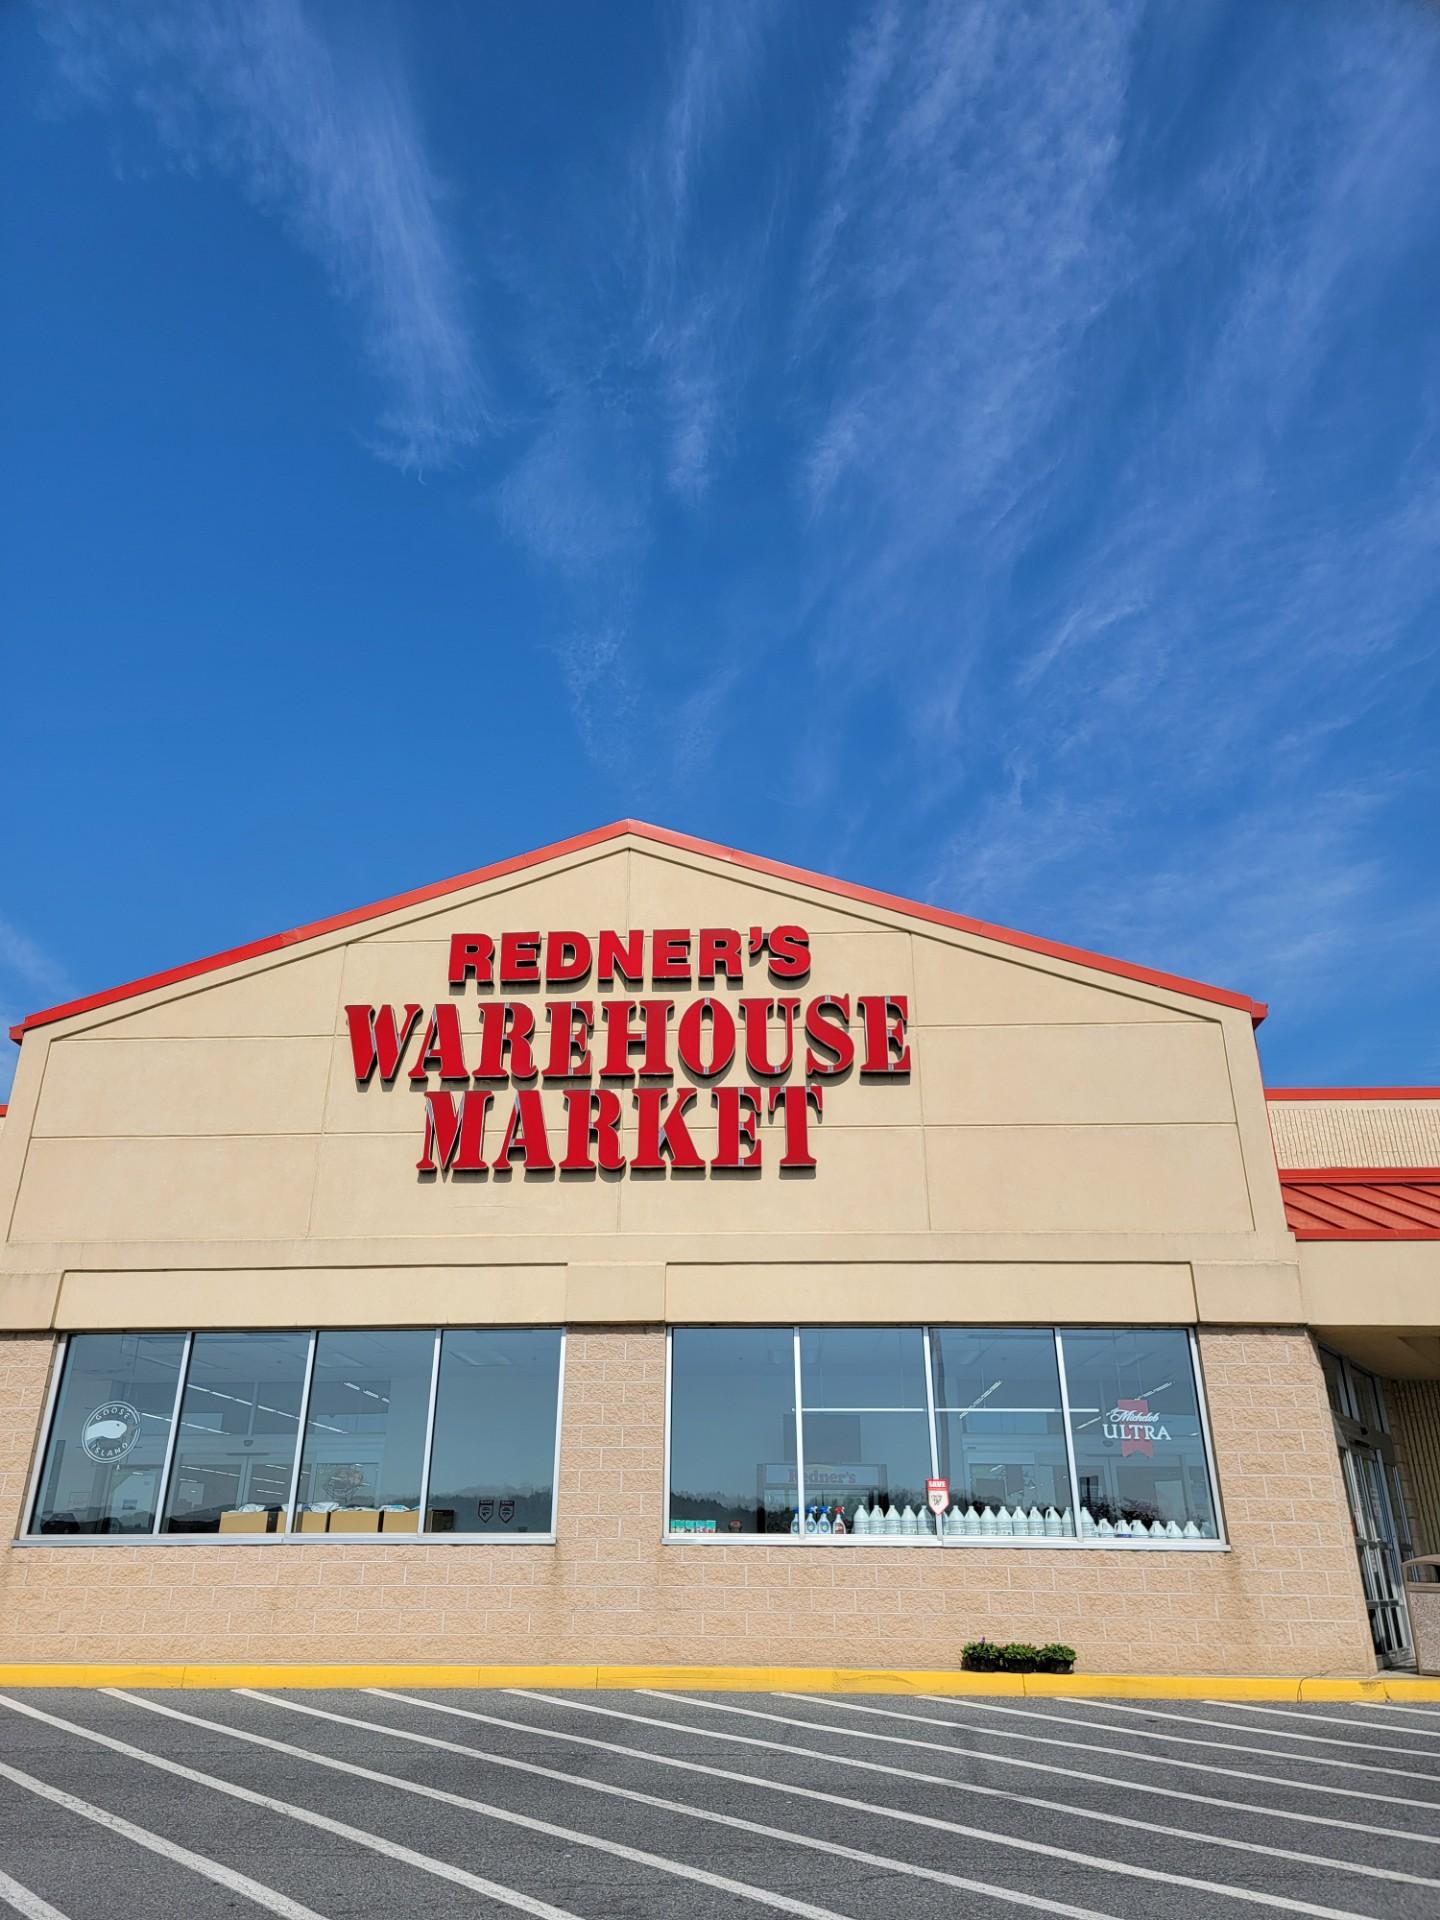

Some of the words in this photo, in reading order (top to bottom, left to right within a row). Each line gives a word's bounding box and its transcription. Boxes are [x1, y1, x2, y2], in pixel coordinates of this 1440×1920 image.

[448, 925, 812, 984] REDNER'S
[344, 993, 912, 1079] WAREHOUSE
[416, 1085, 823, 1171] MARKET
[95, 1407, 130, 1420] GOOSE
[1106, 1408, 1160, 1422] Michelob
[1102, 1423, 1172, 1440] ULTRA
[91, 1442, 128, 1457] ISLAND
